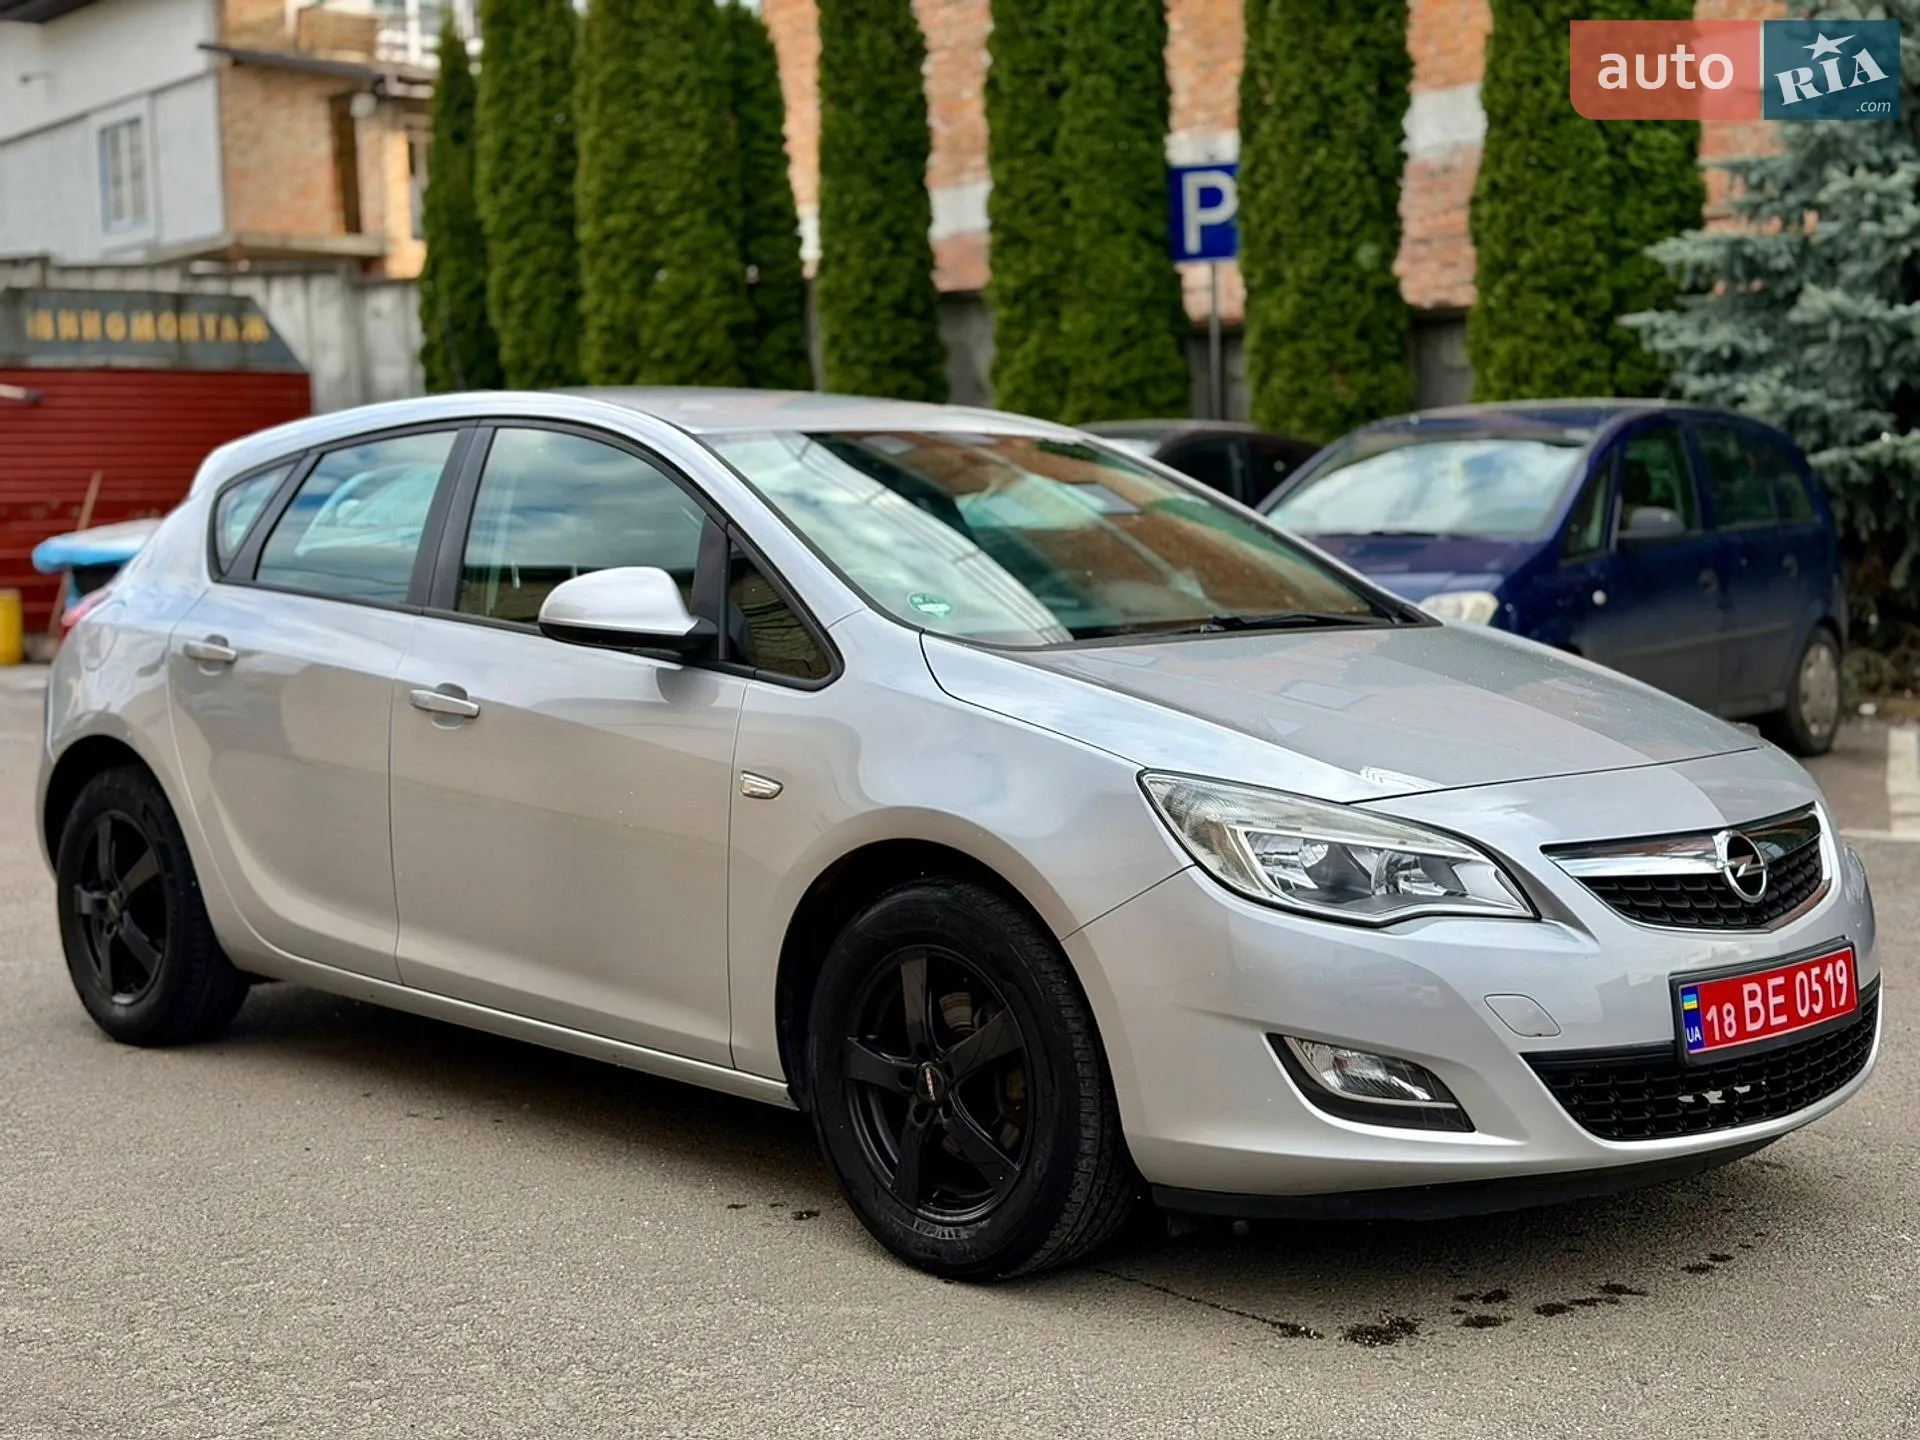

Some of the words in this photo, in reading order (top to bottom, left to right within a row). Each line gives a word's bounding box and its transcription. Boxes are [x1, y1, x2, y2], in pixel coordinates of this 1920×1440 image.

[1181, 170, 1238, 255] P
[1686, 1026, 1702, 1043] UA
[1706, 1002, 1737, 1041] 18
[1742, 976, 1787, 1032] BE
[1795, 959, 1847, 1018] 0519
